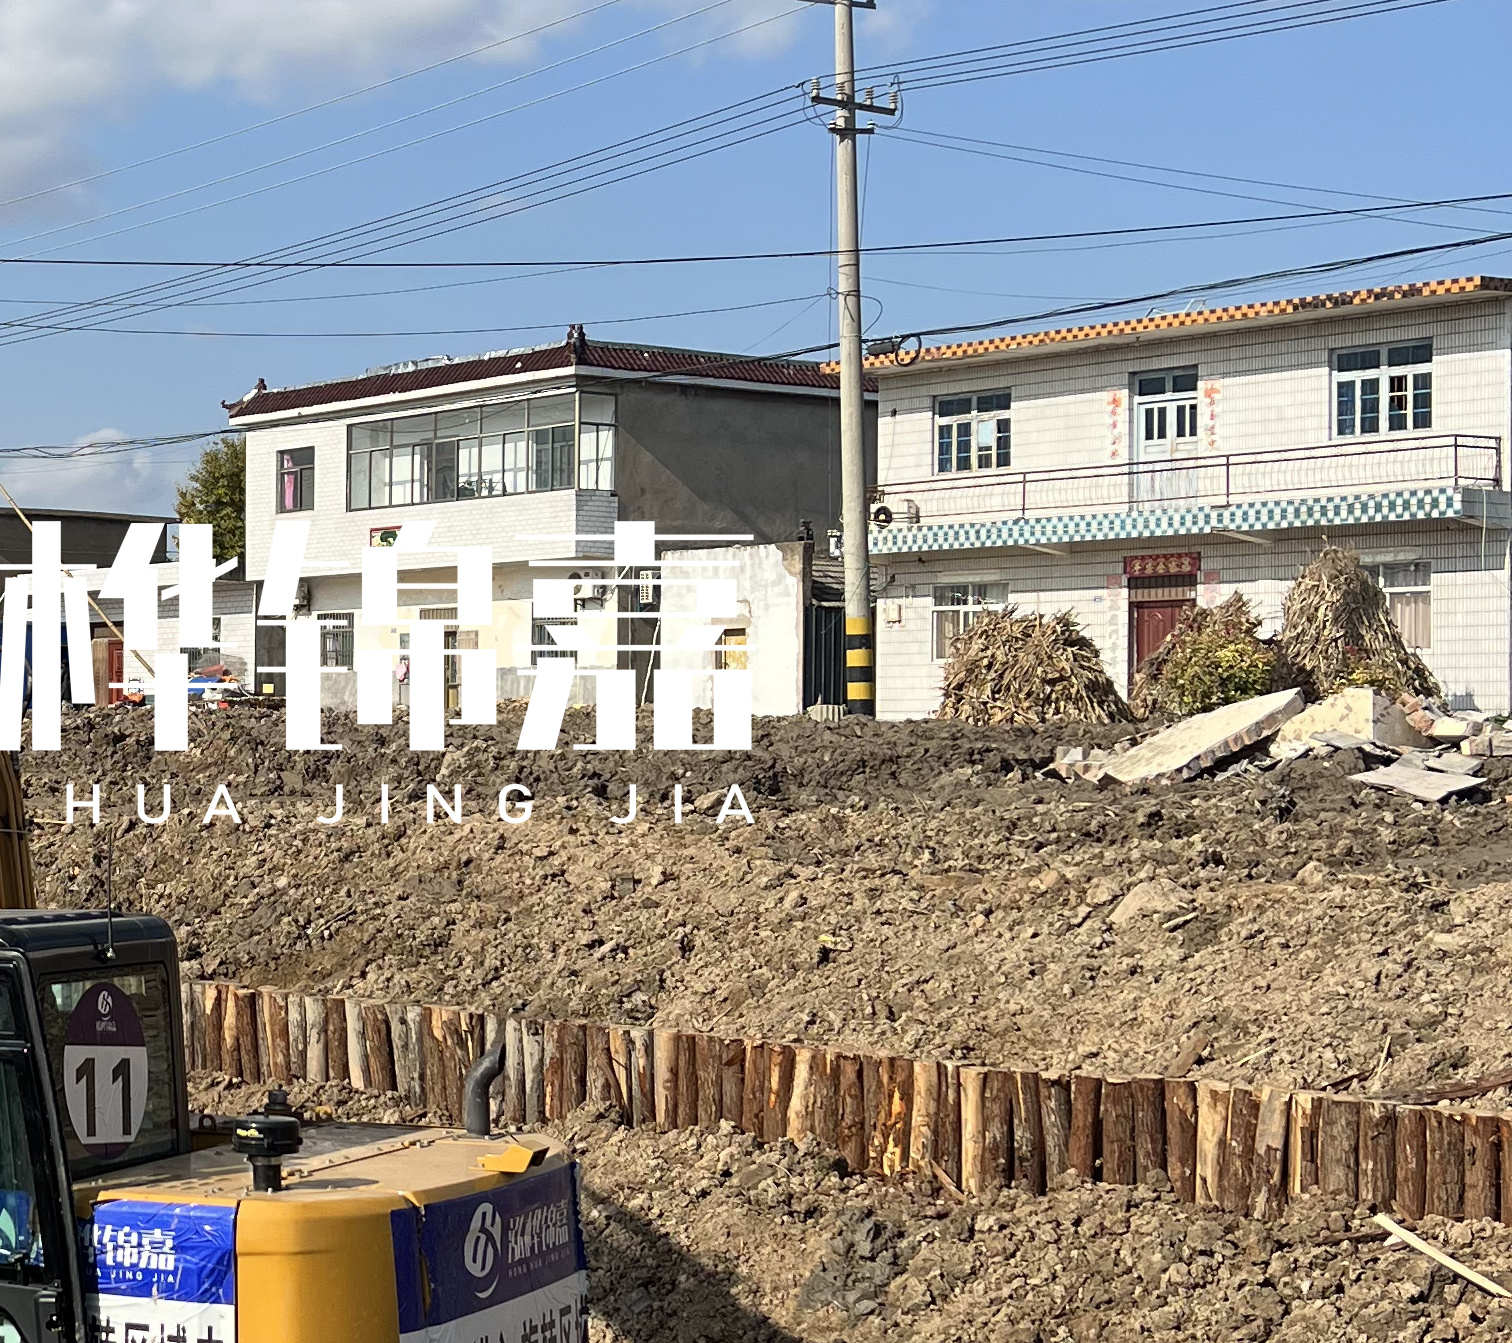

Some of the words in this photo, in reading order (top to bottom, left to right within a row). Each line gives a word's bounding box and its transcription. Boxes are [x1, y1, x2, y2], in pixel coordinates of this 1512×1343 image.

[75, 1057, 132, 1138] 11
[111, 1269, 143, 1281] JING
[152, 1272, 175, 1283] JIA
